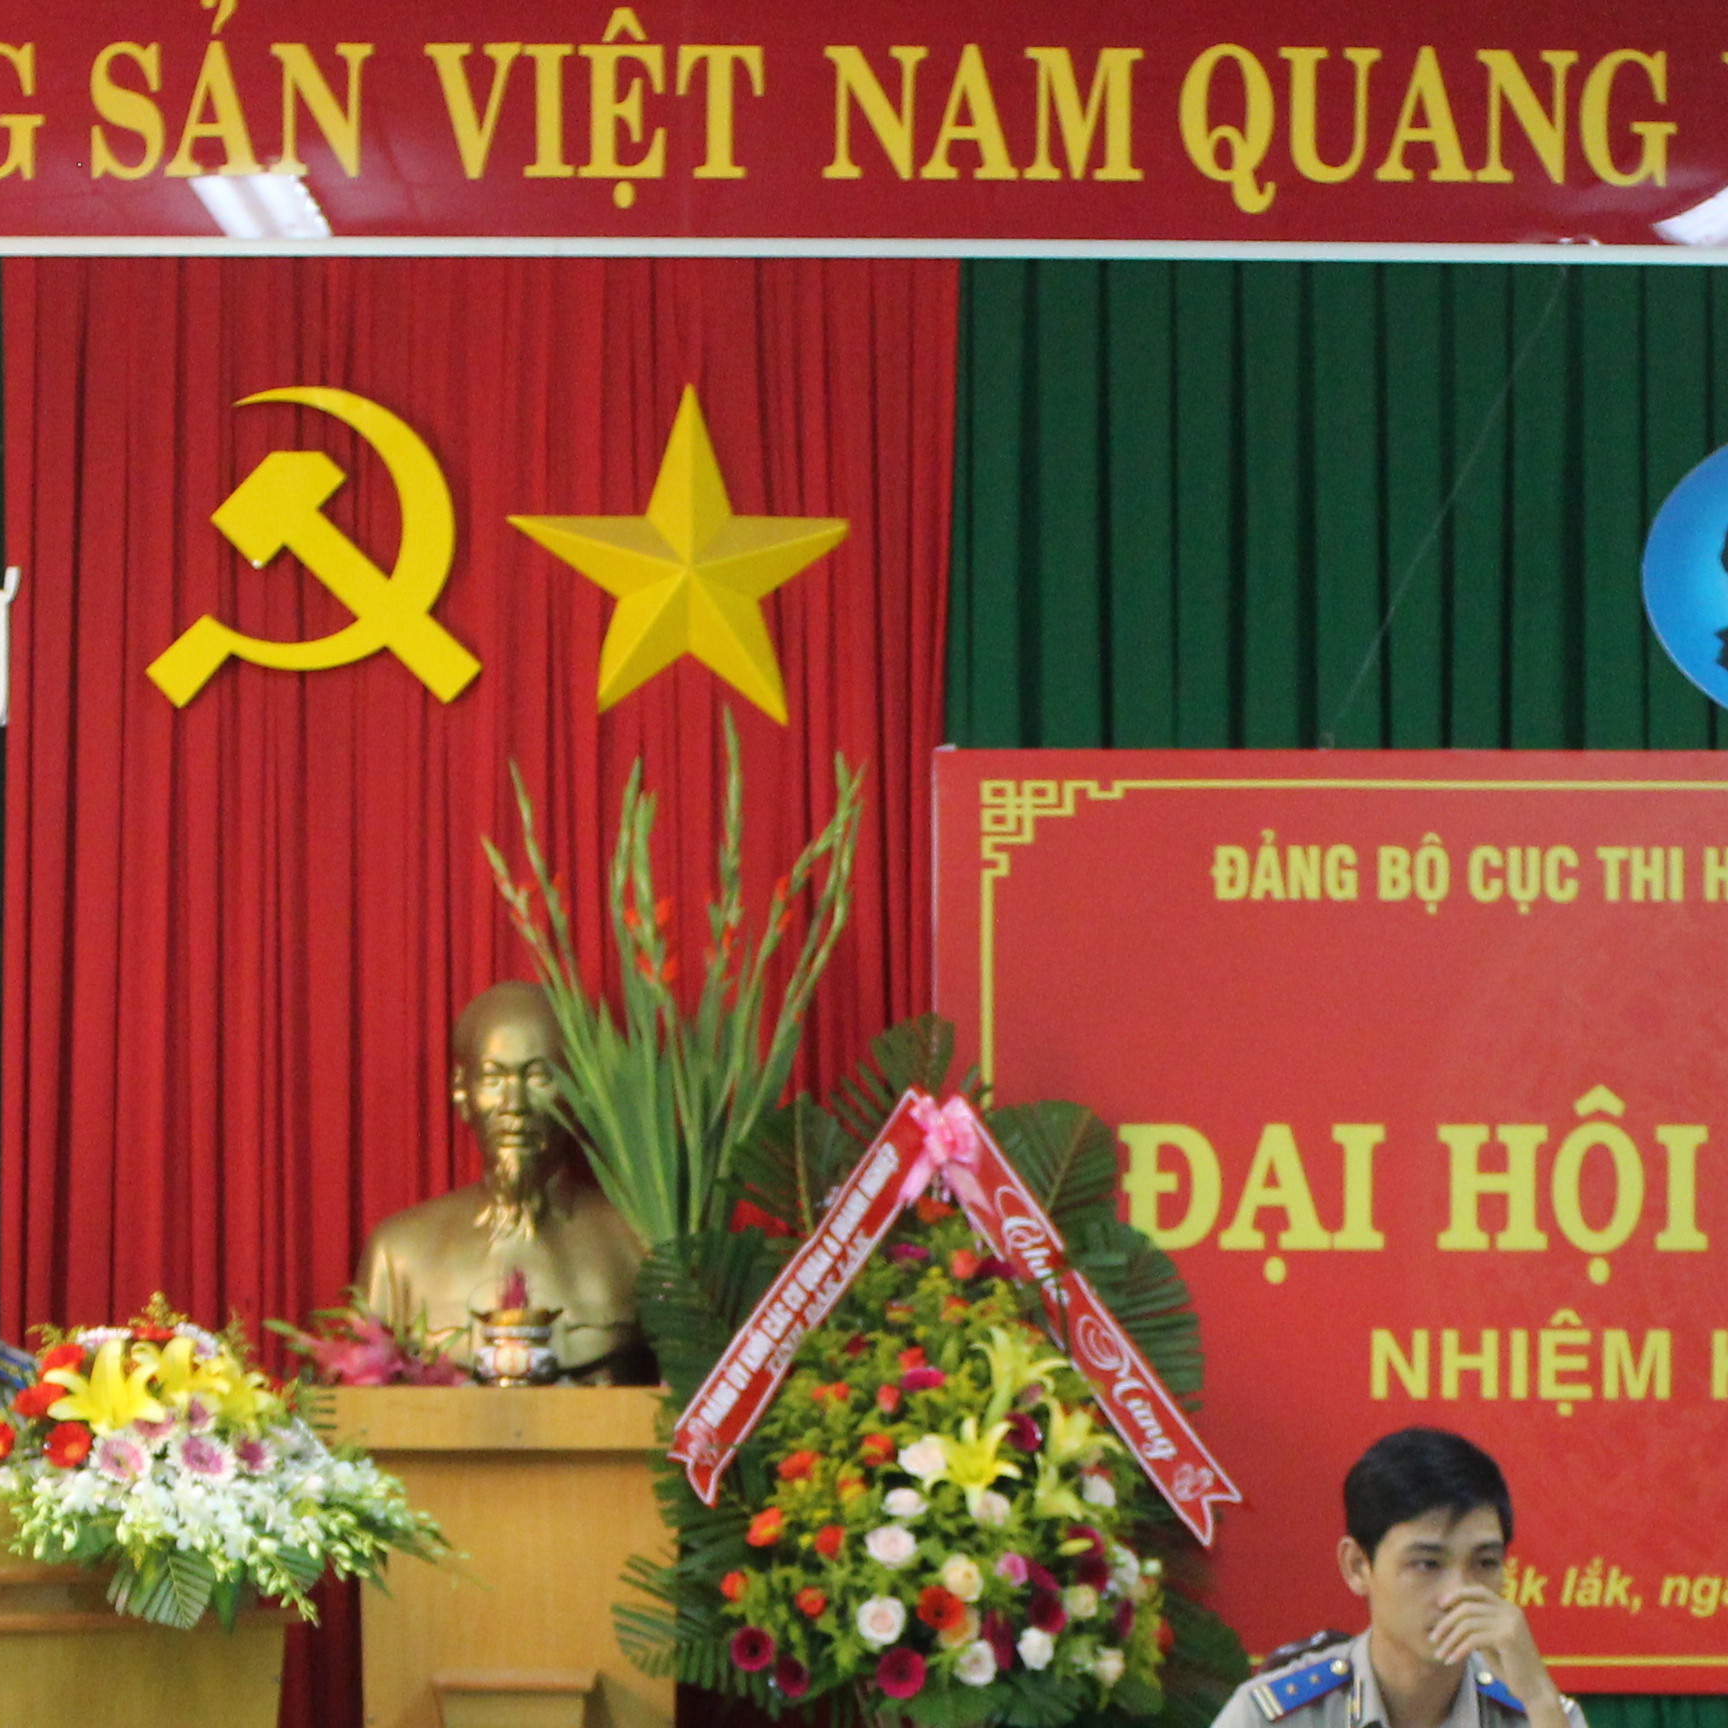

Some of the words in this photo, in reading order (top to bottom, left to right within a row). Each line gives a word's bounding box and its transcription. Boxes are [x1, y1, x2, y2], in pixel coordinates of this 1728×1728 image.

[91, 0, 372, 180] SẢN
[425, 8, 763, 208] VIỆT
[824, 45, 1142, 184] NAM
[1181, 44, 1676, 213] QUANG
[1211, 829, 1359, 901] ĐẢNG
[1377, 833, 1451, 915] BỘ
[1467, 844, 1580, 914] CỤC
[1596, 846, 1685, 902] THI
[1118, 1123, 1386, 1285] ĐẠI
[1436, 1085, 1709, 1285] HỘI
[1370, 1308, 1672, 1417] NHIỆM
[1501, 1556, 1549, 1608] ắk
[1560, 1556, 1643, 1615] lắk,
